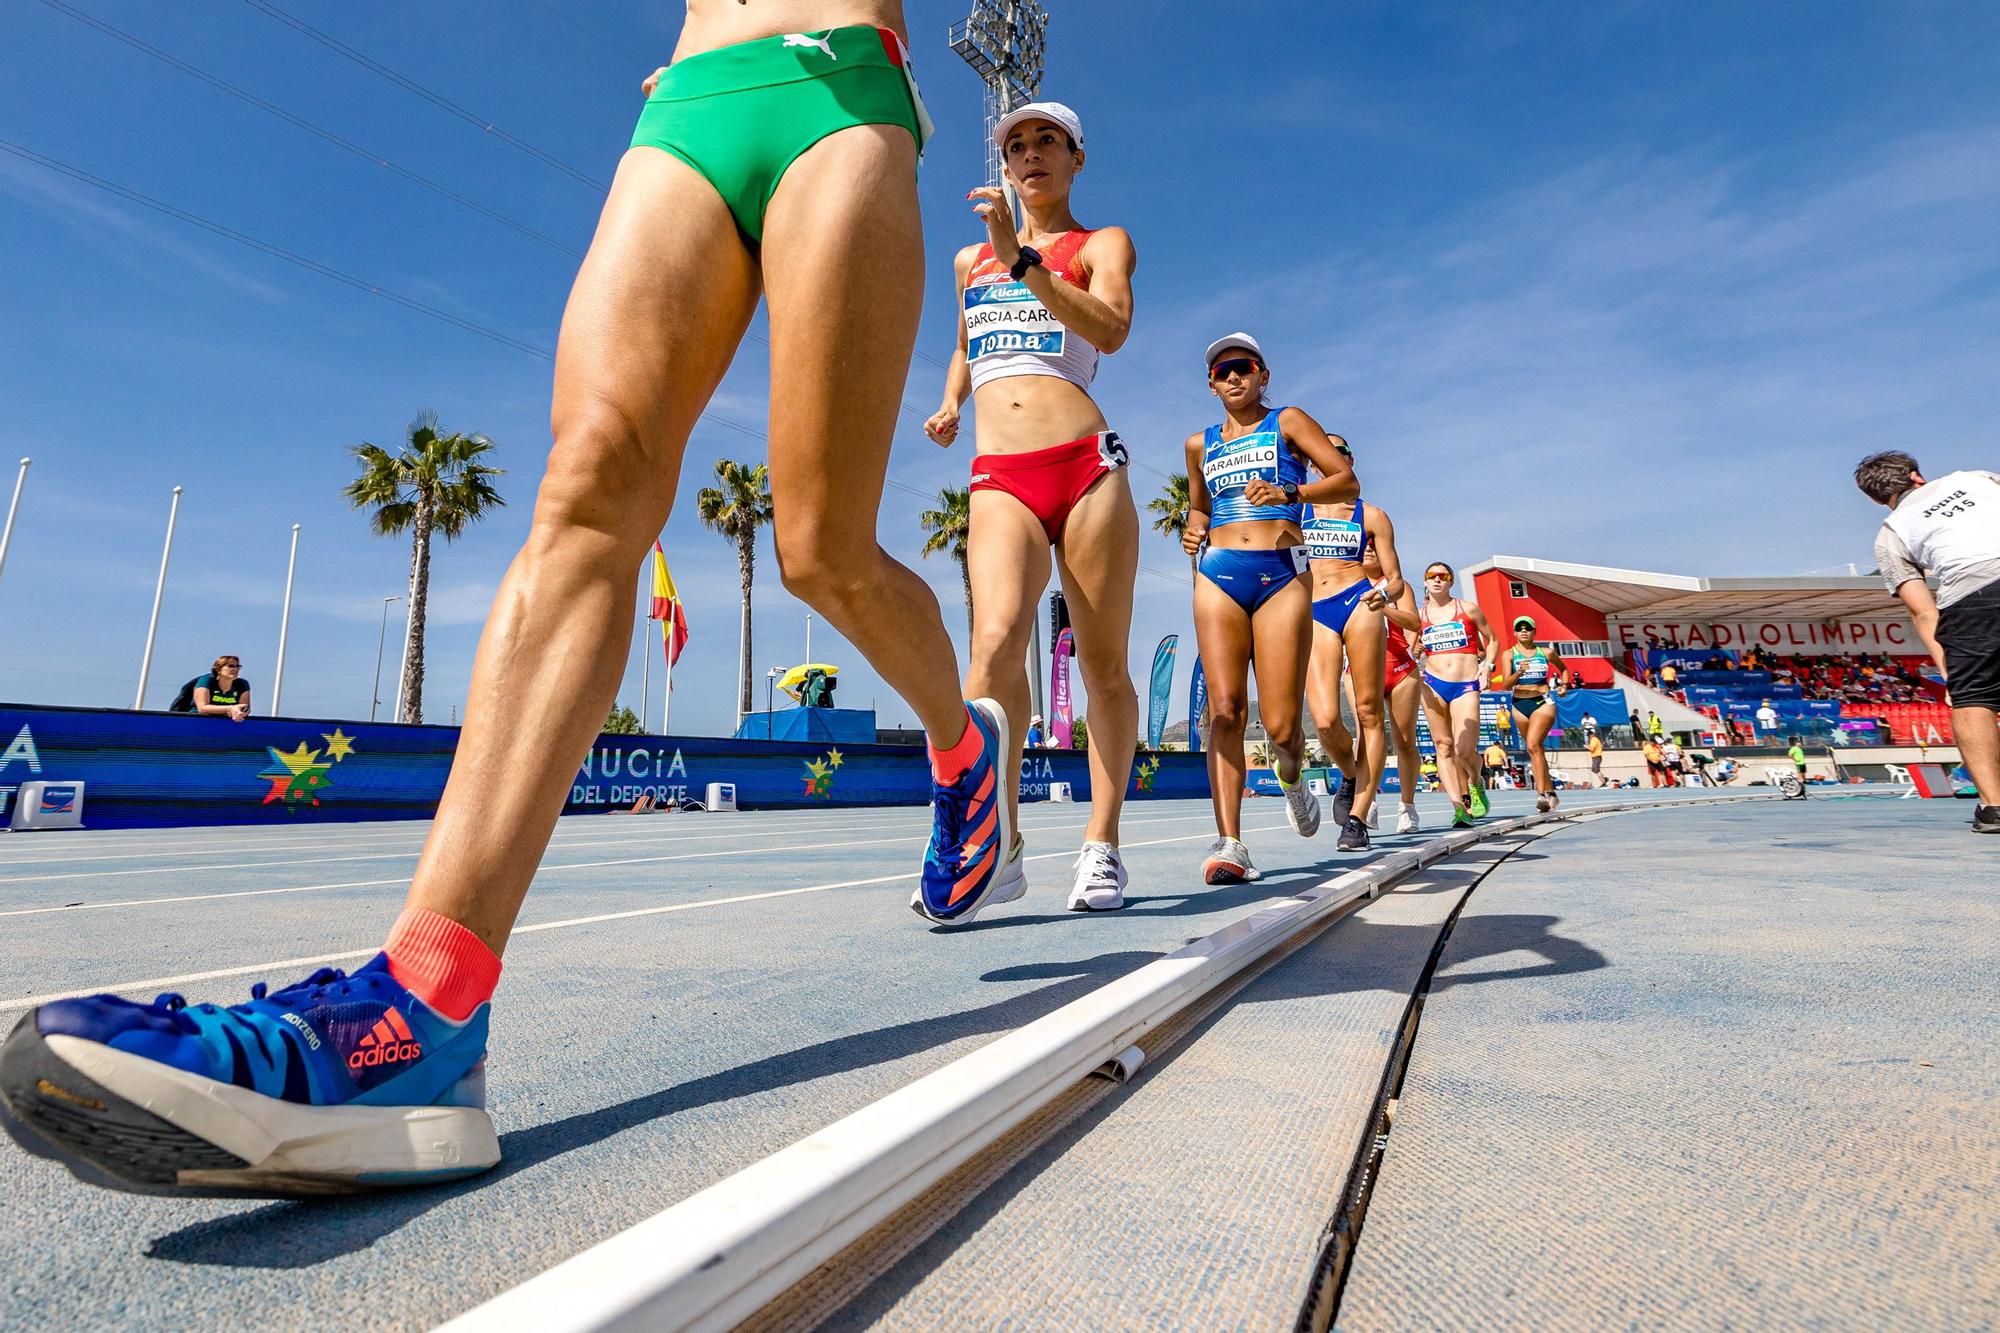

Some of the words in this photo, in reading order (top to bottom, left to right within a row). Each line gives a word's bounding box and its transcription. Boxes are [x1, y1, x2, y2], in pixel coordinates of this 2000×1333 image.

[1104, 432, 1129, 466] 5
[1204, 450, 1275, 477] JARAMILLO
[1302, 532, 1358, 544] SANTANA
[1434, 630, 1464, 640] ORBETA
[1619, 623, 1746, 646] ESTADI
[1759, 622, 1906, 646] OLIMPIC
[1911, 722, 1945, 744] LA
[572, 785, 605, 804] DEL
[610, 785, 687, 803] DEPORTE
[280, 1012, 321, 1051] ADIZERO
[349, 1041, 422, 1069] adidas
